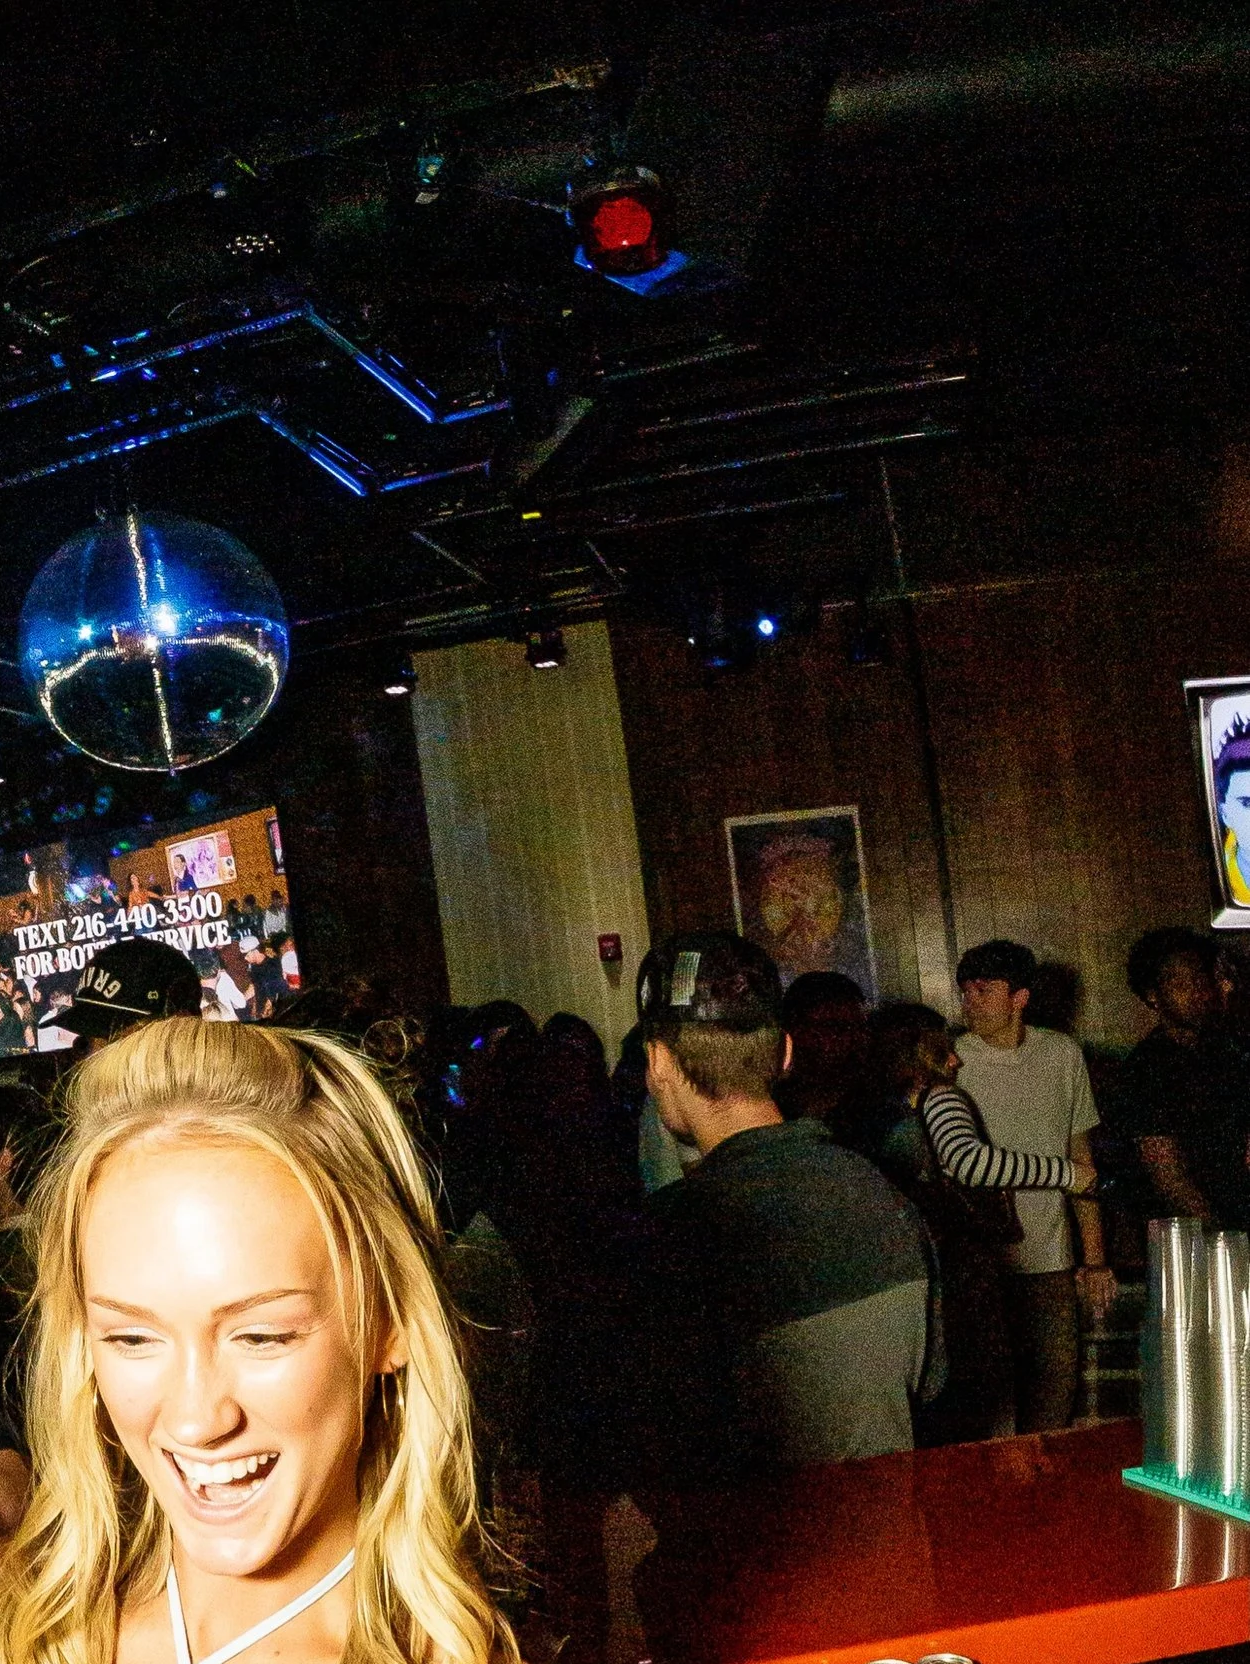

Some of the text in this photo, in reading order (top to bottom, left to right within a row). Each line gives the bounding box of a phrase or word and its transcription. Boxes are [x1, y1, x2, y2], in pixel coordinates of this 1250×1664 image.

[14, 891, 222, 951] TEXT 216-440-3500
[14, 951, 56, 980] FOR
[56, 936, 134, 973] BOT
